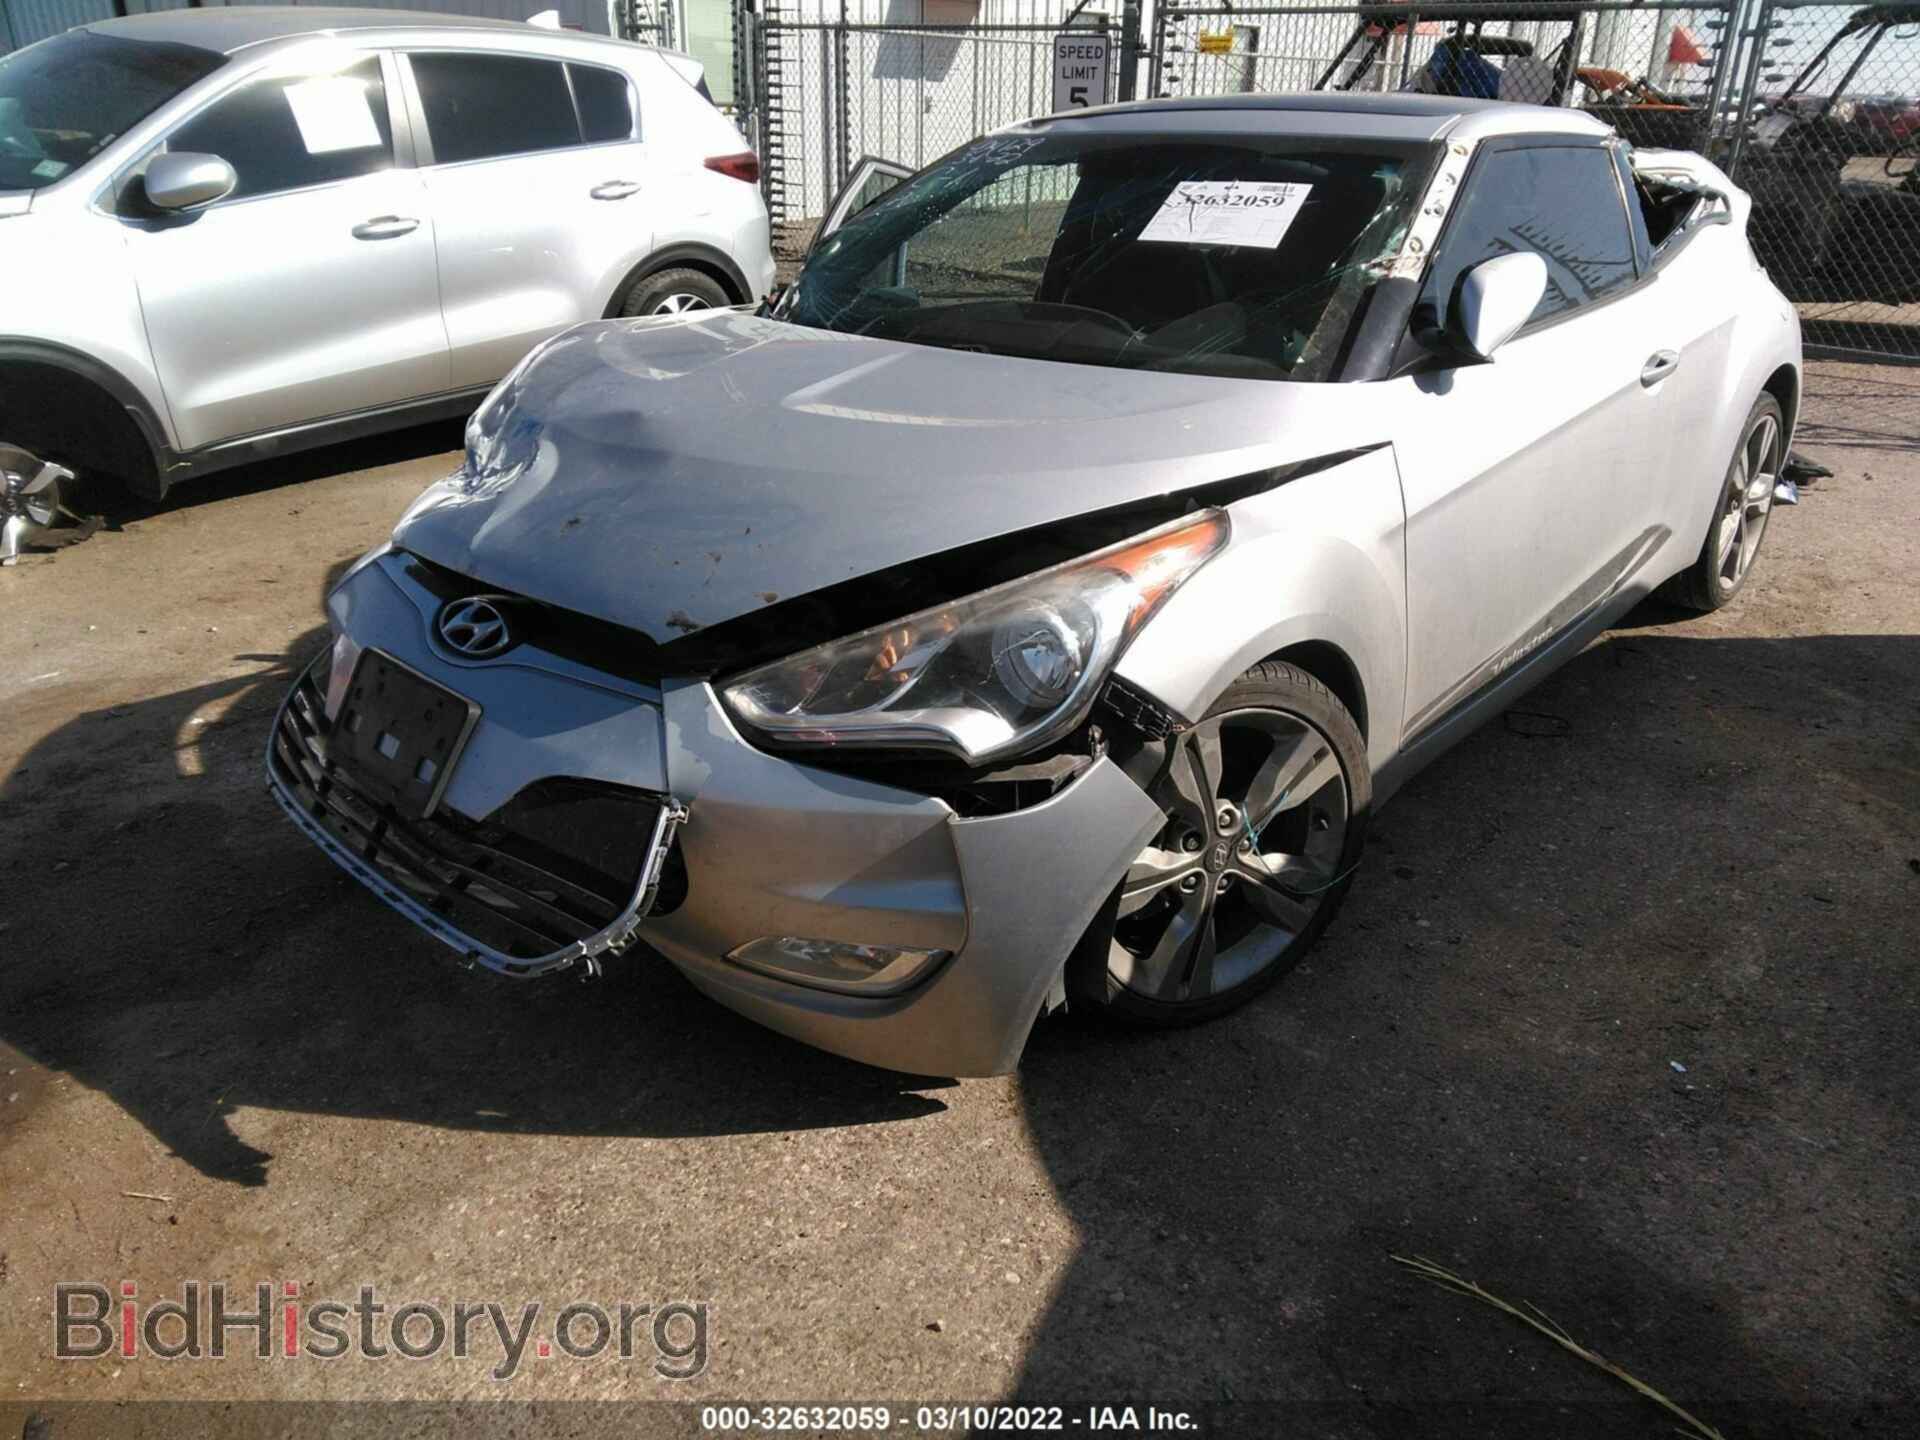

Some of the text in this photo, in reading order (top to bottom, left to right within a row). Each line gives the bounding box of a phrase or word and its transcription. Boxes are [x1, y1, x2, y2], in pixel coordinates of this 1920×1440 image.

[1059, 45, 1104, 60] SPEED
[1062, 65, 1099, 80] LIMIT
[1070, 86, 1089, 108] 5
